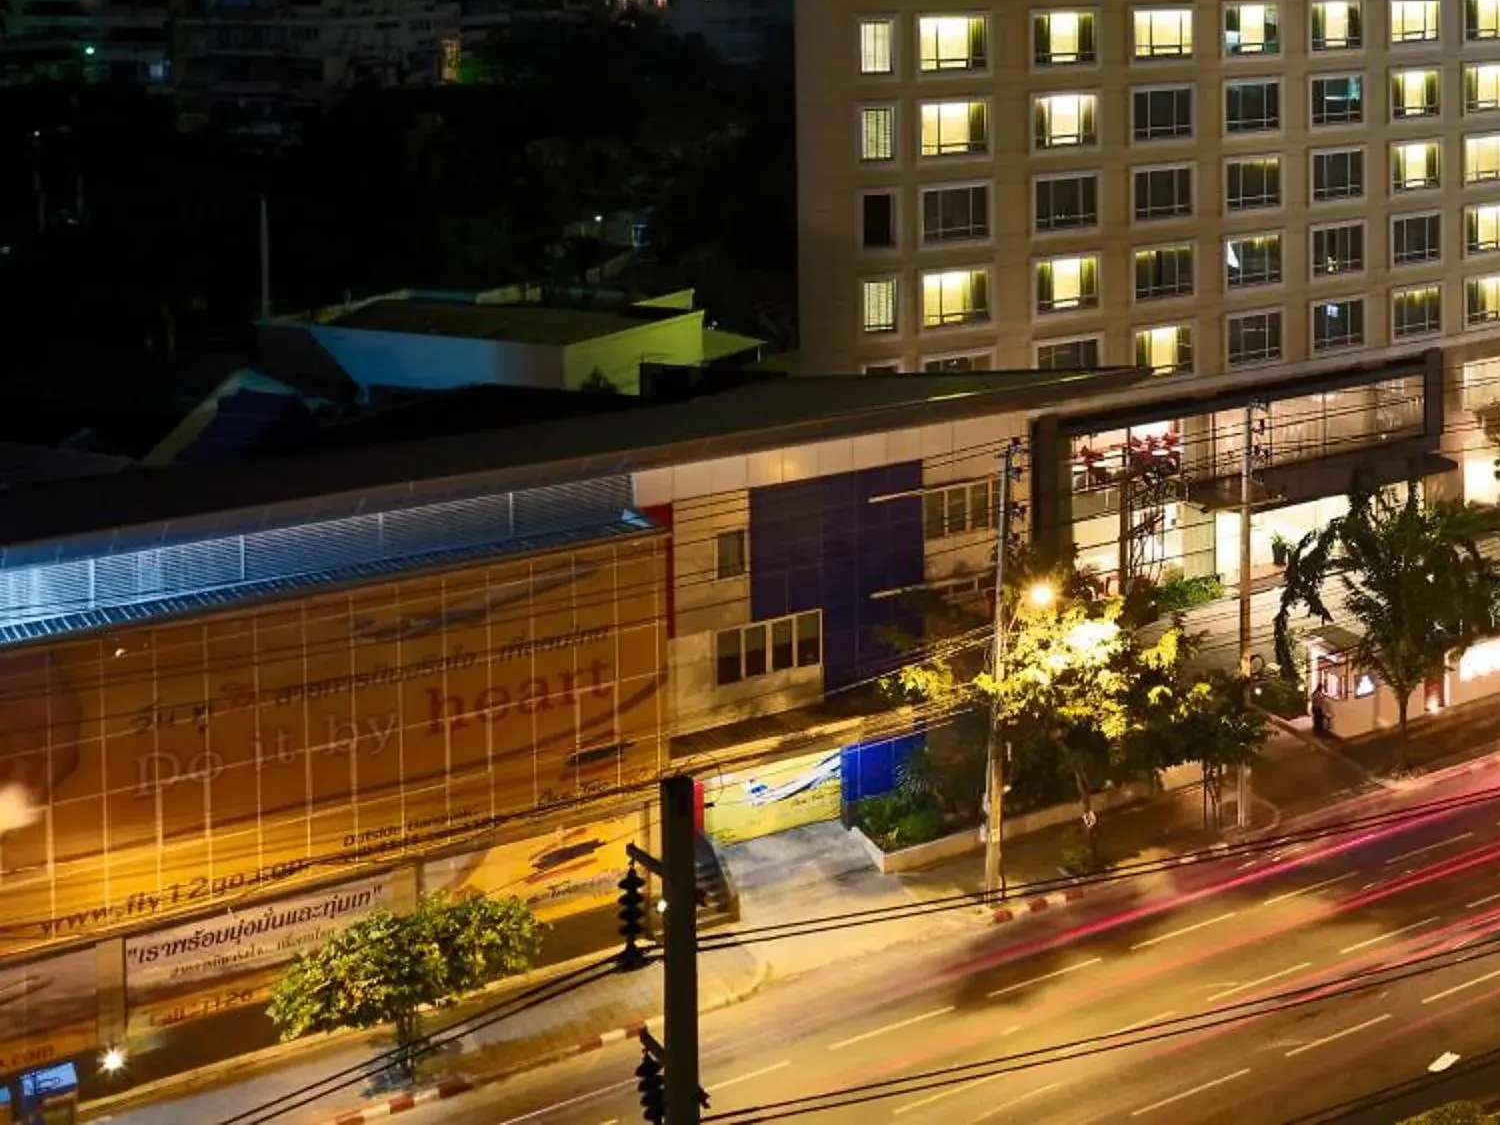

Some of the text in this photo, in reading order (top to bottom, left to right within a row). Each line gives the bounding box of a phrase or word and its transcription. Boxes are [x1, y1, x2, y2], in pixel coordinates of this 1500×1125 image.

[134, 657, 615, 798] Do it by heart
